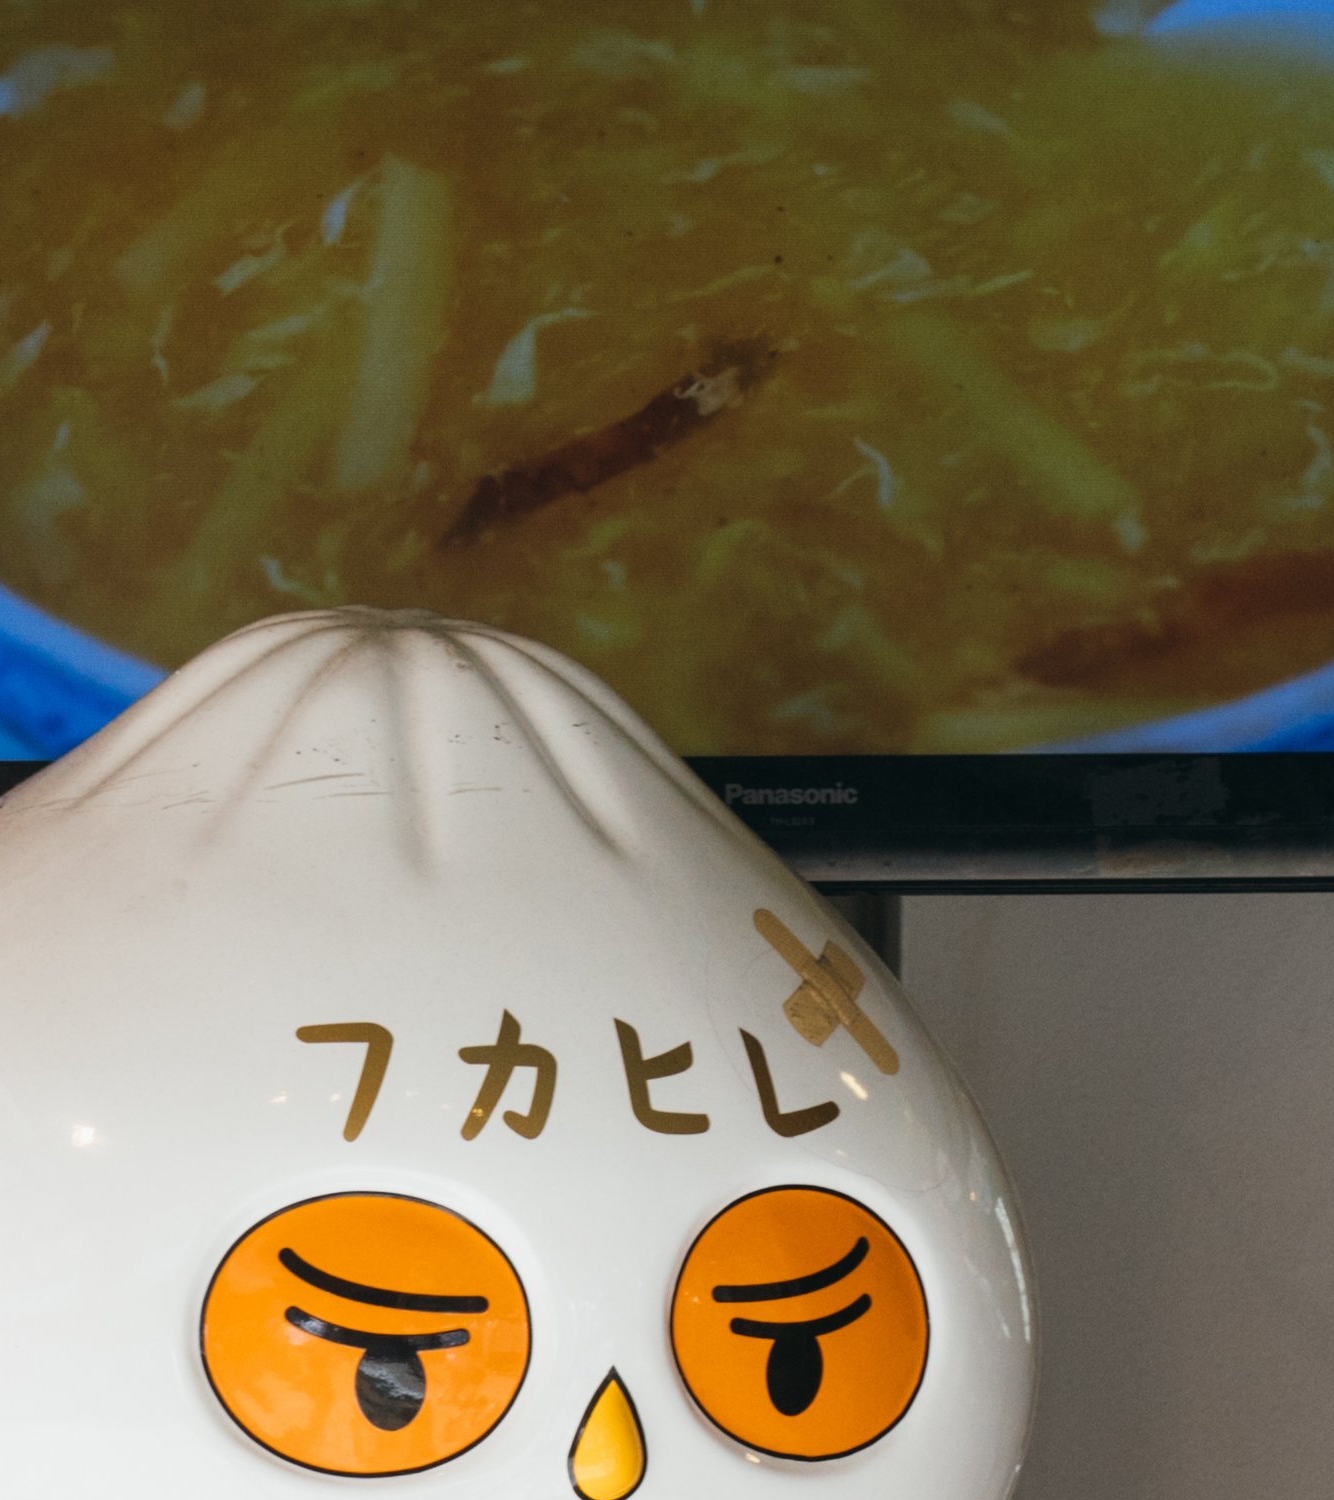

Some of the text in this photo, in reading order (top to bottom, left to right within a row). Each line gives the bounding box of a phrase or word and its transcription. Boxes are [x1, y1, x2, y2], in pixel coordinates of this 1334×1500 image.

[725, 783, 859, 806] Panasonic
[296, 1008, 841, 1142] フカヒレ
